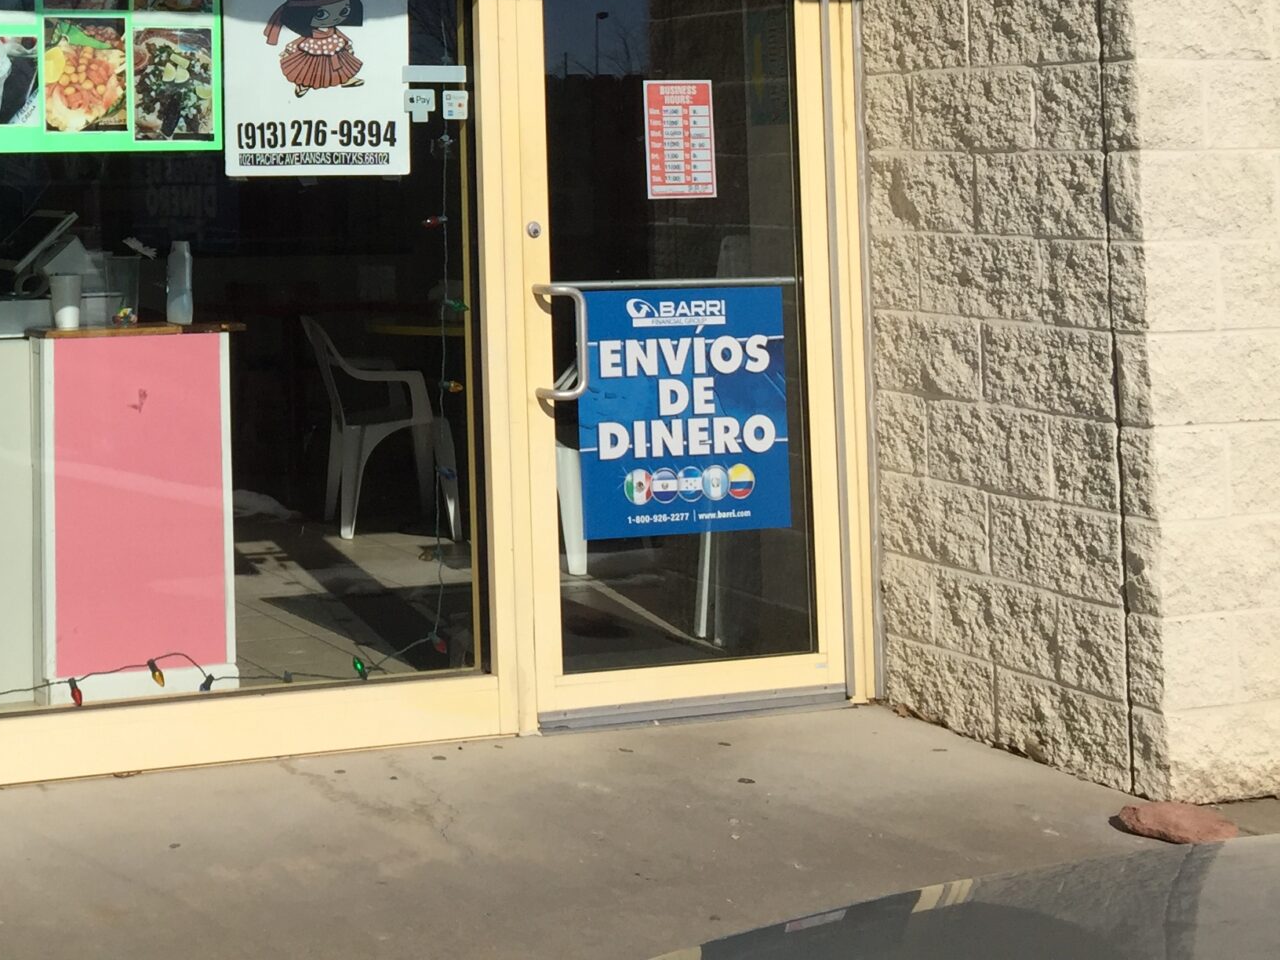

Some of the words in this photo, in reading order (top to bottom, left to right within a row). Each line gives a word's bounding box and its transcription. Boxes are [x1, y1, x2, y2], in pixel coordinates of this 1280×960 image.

[416, 95, 431, 105] Pay
[658, 299, 727, 318] BARRI
[651, 318, 684, 326] FINANCIAL
[598, 324, 771, 378] ENVÍOS
[658, 376, 717, 417] DE
[597, 413, 777, 461] DINERO
[698, 509, 752, 521] www.barri.com
